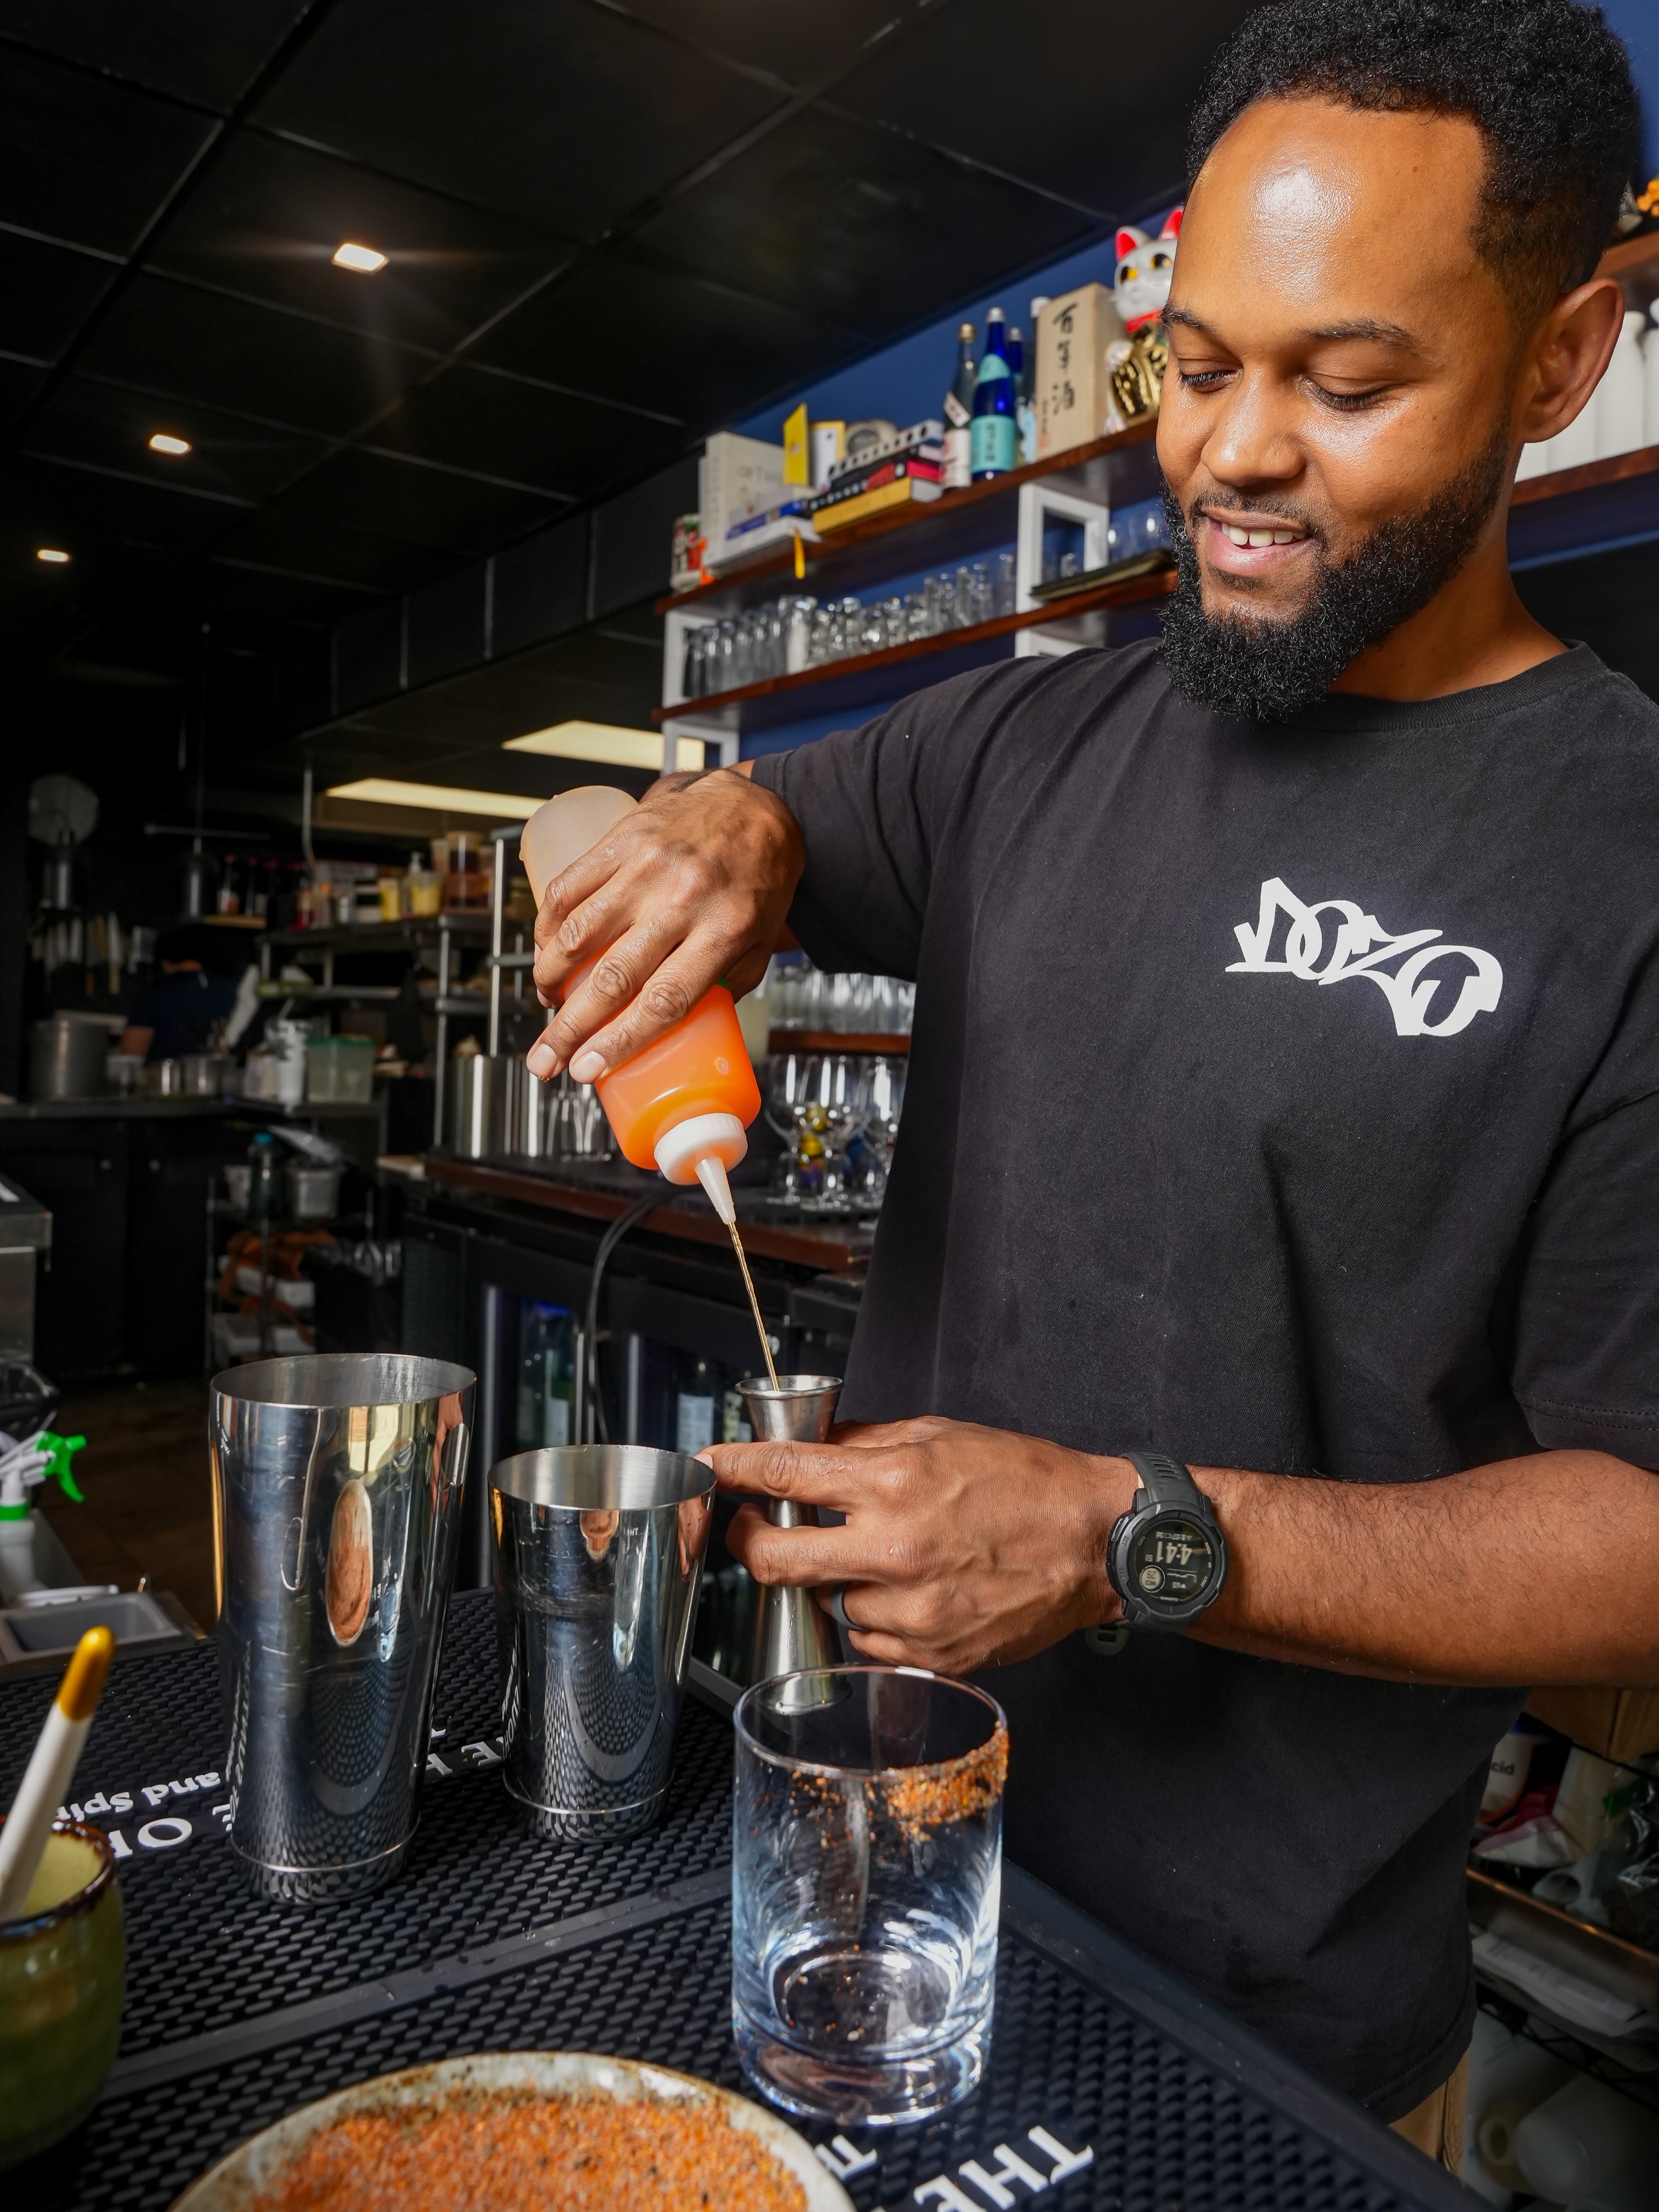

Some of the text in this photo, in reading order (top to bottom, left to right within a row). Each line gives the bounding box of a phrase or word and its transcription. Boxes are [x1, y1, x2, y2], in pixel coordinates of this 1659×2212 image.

[1156, 1541, 1192, 1565] 4:41
[1201, 1576, 1209, 1588] LIGHT
[1490, 1760, 1515, 1775] cid
[141, 1772, 221, 1805] and
[913, 2125, 1094, 2212] THE
